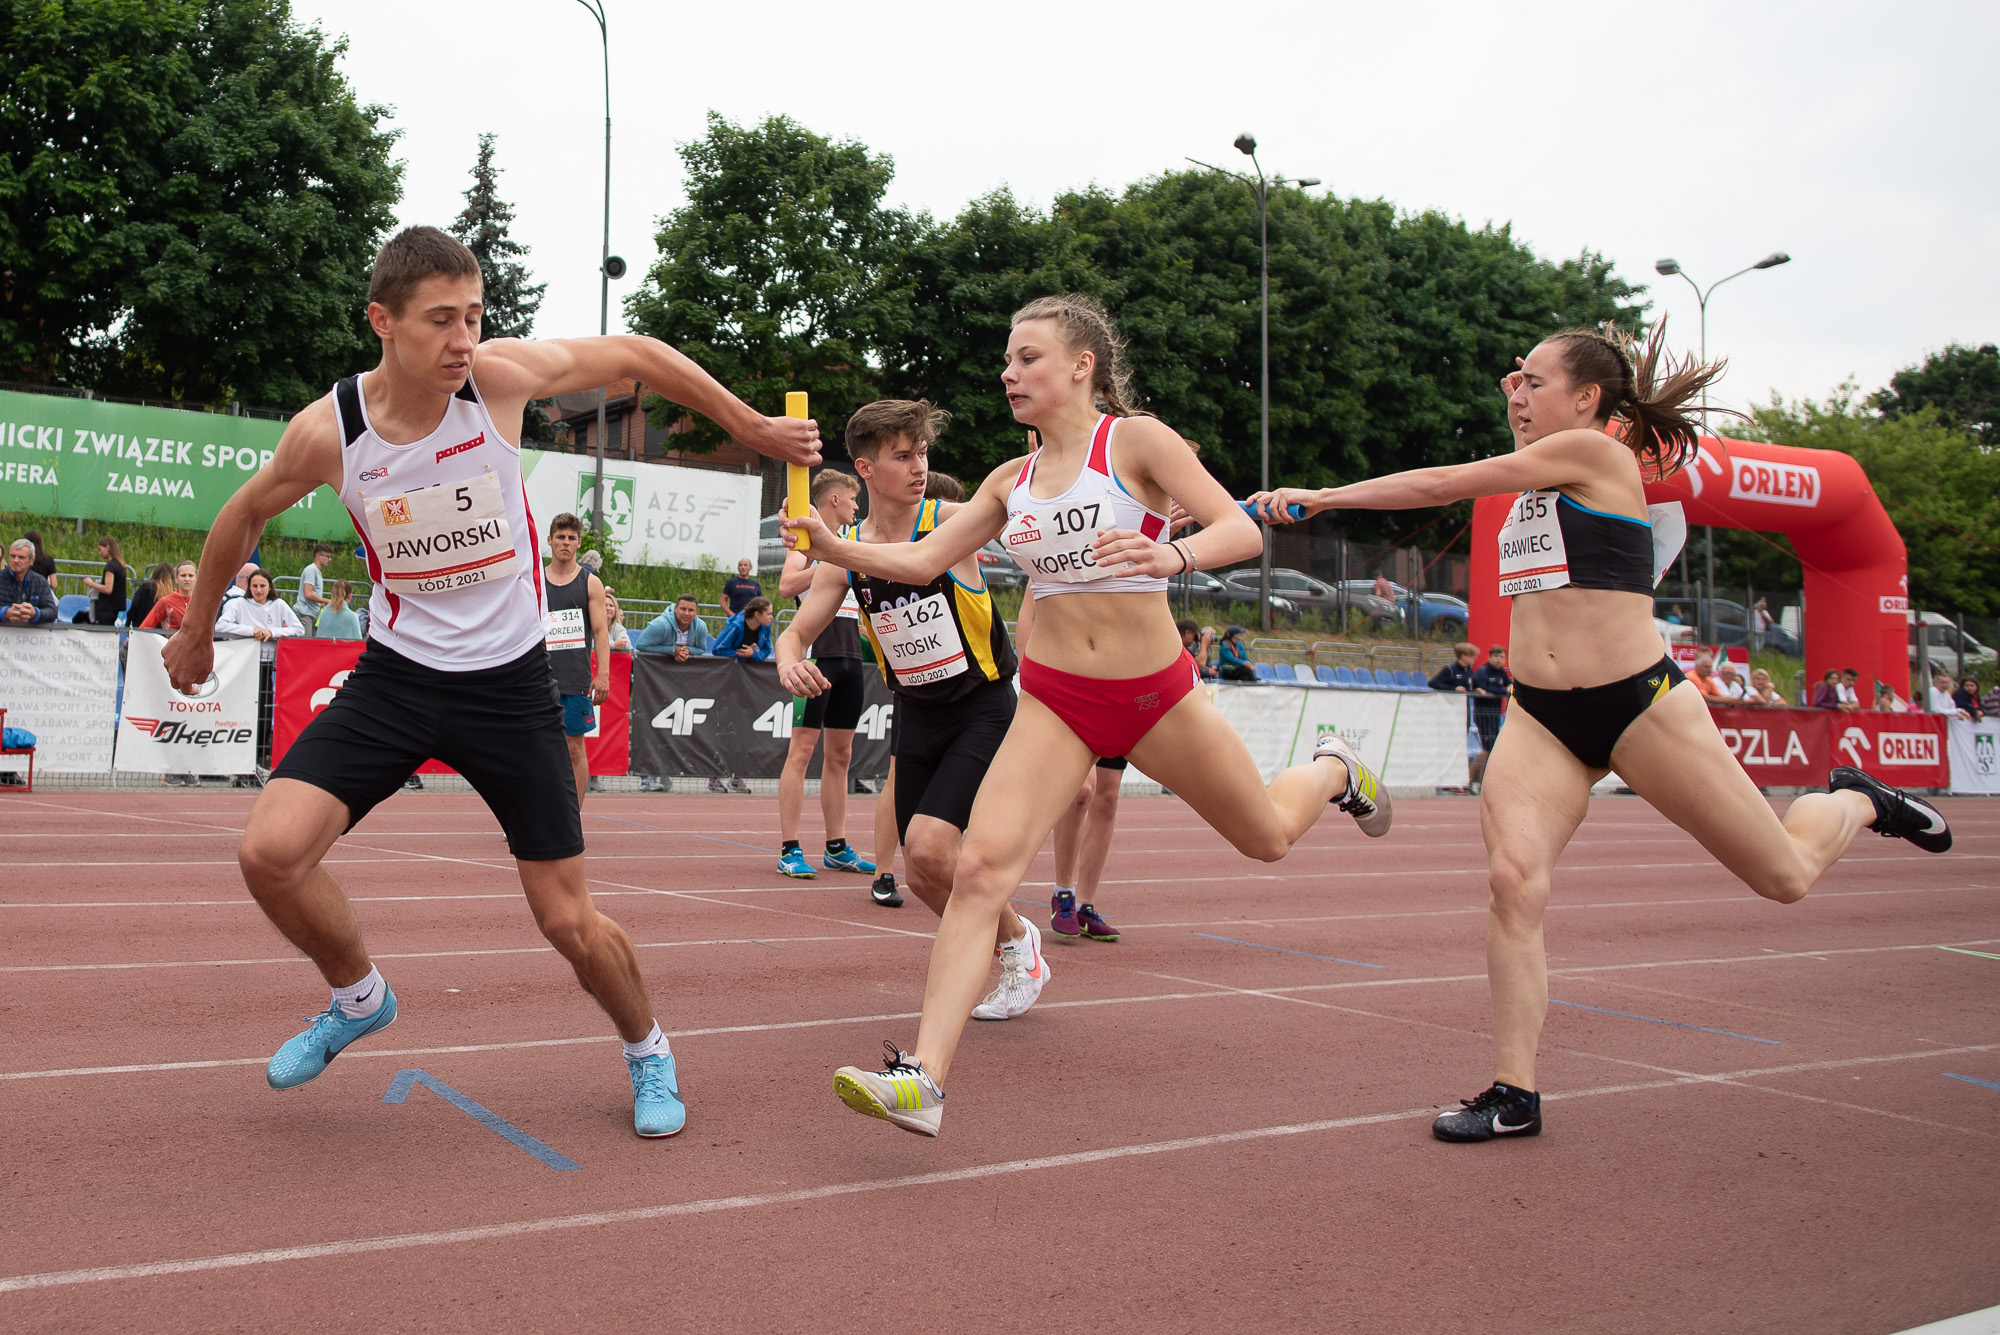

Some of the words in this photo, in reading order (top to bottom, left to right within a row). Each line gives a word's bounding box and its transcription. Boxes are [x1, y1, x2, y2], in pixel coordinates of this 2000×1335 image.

[72, 429, 193, 468] ZWIĄZEK
[106, 472, 195, 499] ZABAWA
[1739, 464, 1814, 500] ORLEN
[455, 486, 473, 512] 5
[647, 490, 696, 514] AZS
[1518, 496, 1547, 523] 155
[645, 515, 705, 544] ŁÓDŹ
[1052, 503, 1101, 536] 107
[387, 519, 501, 559] JAWORSKI
[1010, 531, 1040, 544] ORLEN
[1031, 544, 1097, 575] KOPEĆ
[418, 575, 453, 592] ŁÓDŹ
[456, 570, 486, 586] 2021
[1503, 579, 1522, 593] ŁÓDŹ
[1523, 578, 1542, 590] 2021
[561, 611, 580, 621] 314
[902, 600, 944, 629] 162
[549, 625, 583, 636] DRZEJAK
[877, 624, 897, 634] ORLEN
[16, 635, 53, 646] SPORT
[892, 633, 942, 658] STOSIK
[52, 654, 89, 665] SPORT
[907, 671, 927, 684] ŁÓDŹ
[928, 667, 949, 681] 2021
[22, 686, 59, 697] SPORT
[64, 688, 115, 699] ATMOSFE
[44, 702, 80, 713] SPORT
[168, 700, 221, 713] TOYOTA
[651, 697, 715, 735] 4F
[34, 718, 79, 729] ZABAWA
[55, 752, 93, 762] SPORT
[1720, 728, 1809, 765] PZLA
[1883, 738, 1935, 760] ORLEN
